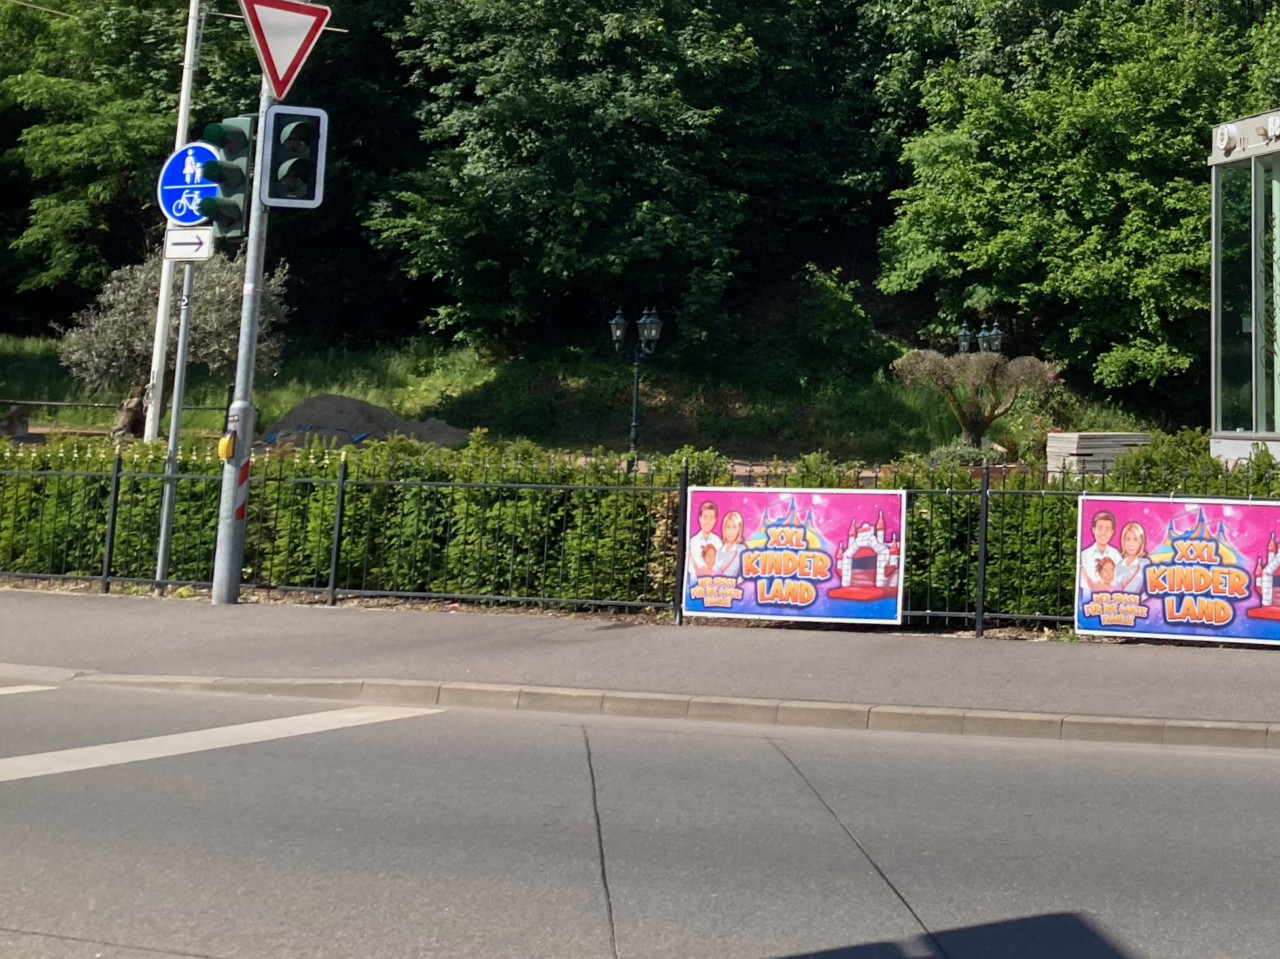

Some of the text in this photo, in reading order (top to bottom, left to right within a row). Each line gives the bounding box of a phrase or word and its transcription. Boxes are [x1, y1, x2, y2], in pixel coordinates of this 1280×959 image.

[767, 528, 806, 549] XXL
[1176, 540, 1218, 563] XXL
[743, 551, 831, 579] KINDER
[756, 579, 816, 605] LAND
[1146, 566, 1249, 597] KINDER
[1165, 597, 1233, 625] LAND
